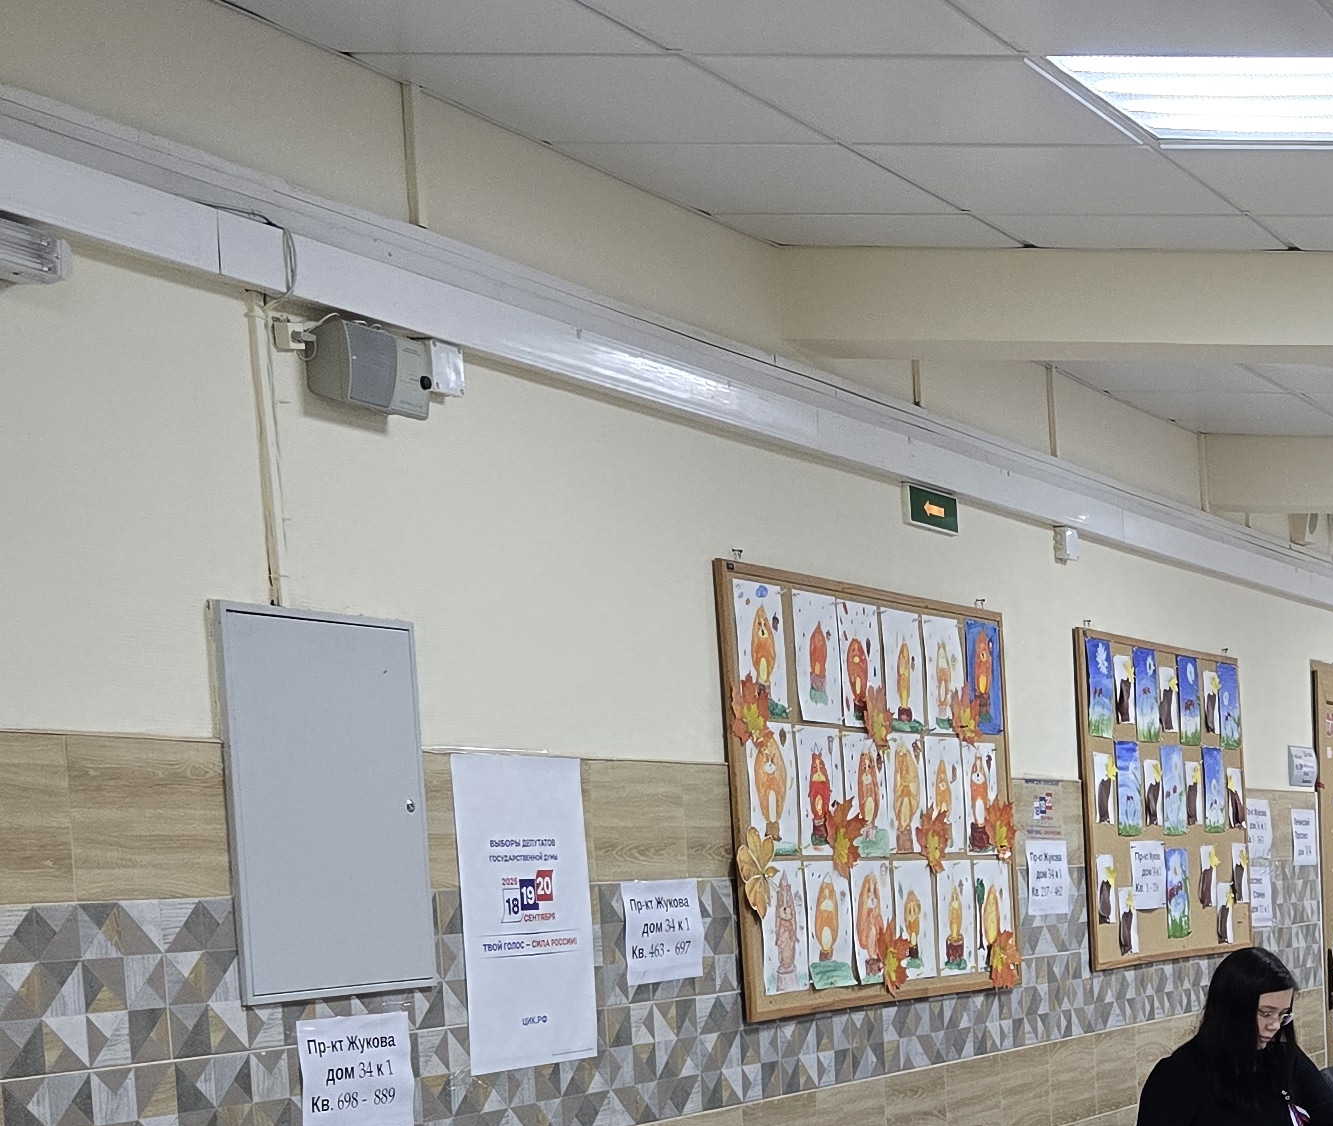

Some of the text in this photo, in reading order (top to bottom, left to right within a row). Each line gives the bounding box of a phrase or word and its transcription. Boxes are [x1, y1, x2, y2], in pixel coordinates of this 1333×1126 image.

[490, 838, 556, 848] ВЫБОРЫ ДЕПУТАТОВ
[489, 852, 543, 863] ГОСУДАРСТВЕННОЙ
[536, 876, 552, 895] 20
[521, 886, 535, 905] 19
[630, 896, 690, 914] Пр-кт Жукова
[506, 897, 519, 915] 18
[524, 912, 556, 923] СЕНТЯБРЯ
[642, 917, 690, 938] дом 34 к 1
[483, 940, 503, 952] ТВОЙ
[503, 941, 525, 951] ГОЛОС
[532, 939, 550, 948] СИЛА
[631, 945, 647, 960] Кв.
[649, 943, 665, 958] 463
[675, 940, 691, 956] 697
[307, 1035, 396, 1058] Пр-кт Жукова
[325, 1059, 394, 1086] дом 34 к 1
[311, 1095, 334, 1113] Кв.
[337, 1091, 359, 1110] 698
[373, 1087, 396, 1105] 889
